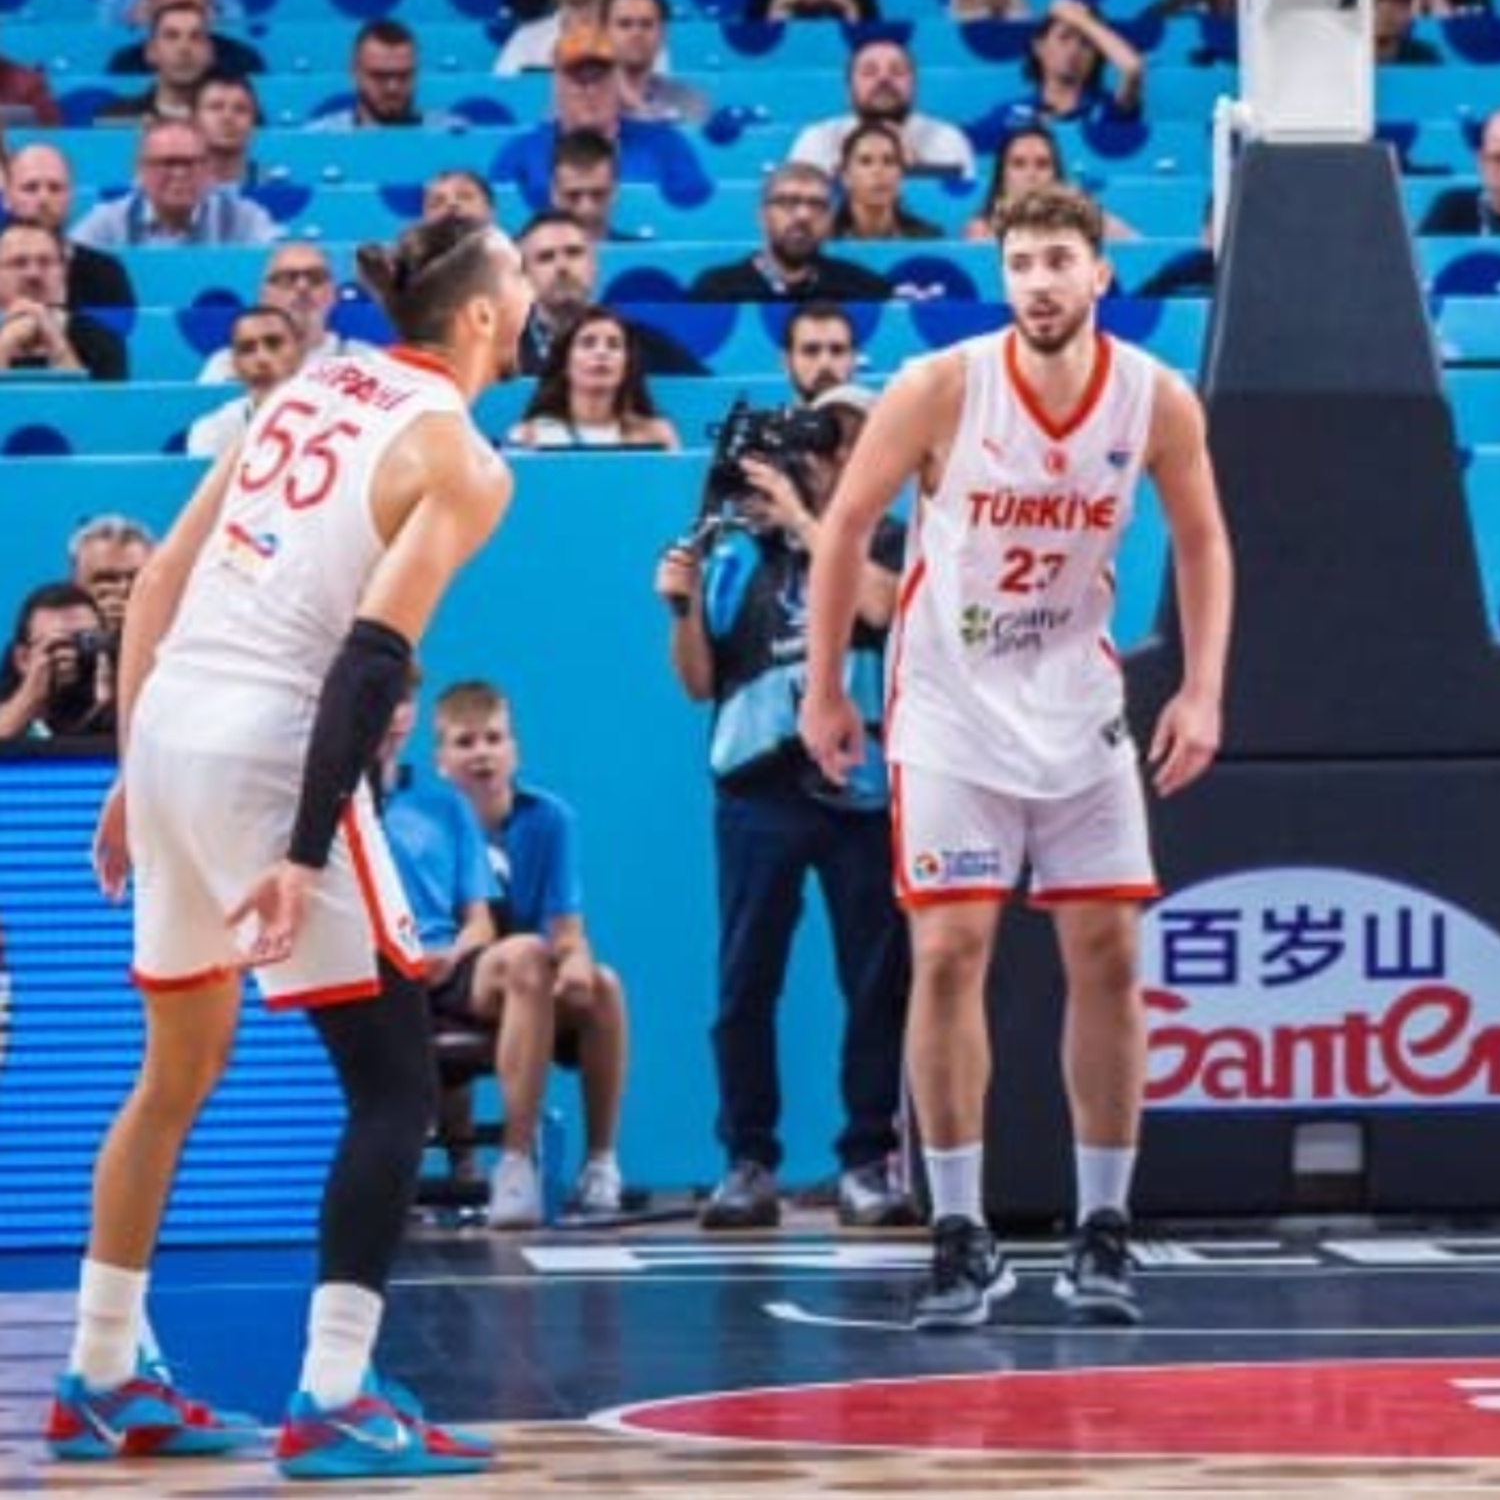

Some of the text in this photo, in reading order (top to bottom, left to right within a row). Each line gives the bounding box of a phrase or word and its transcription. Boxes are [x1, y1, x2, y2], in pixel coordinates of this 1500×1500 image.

[240, 399, 362, 510] 55
[1158, 905, 1446, 987] 百岁山
